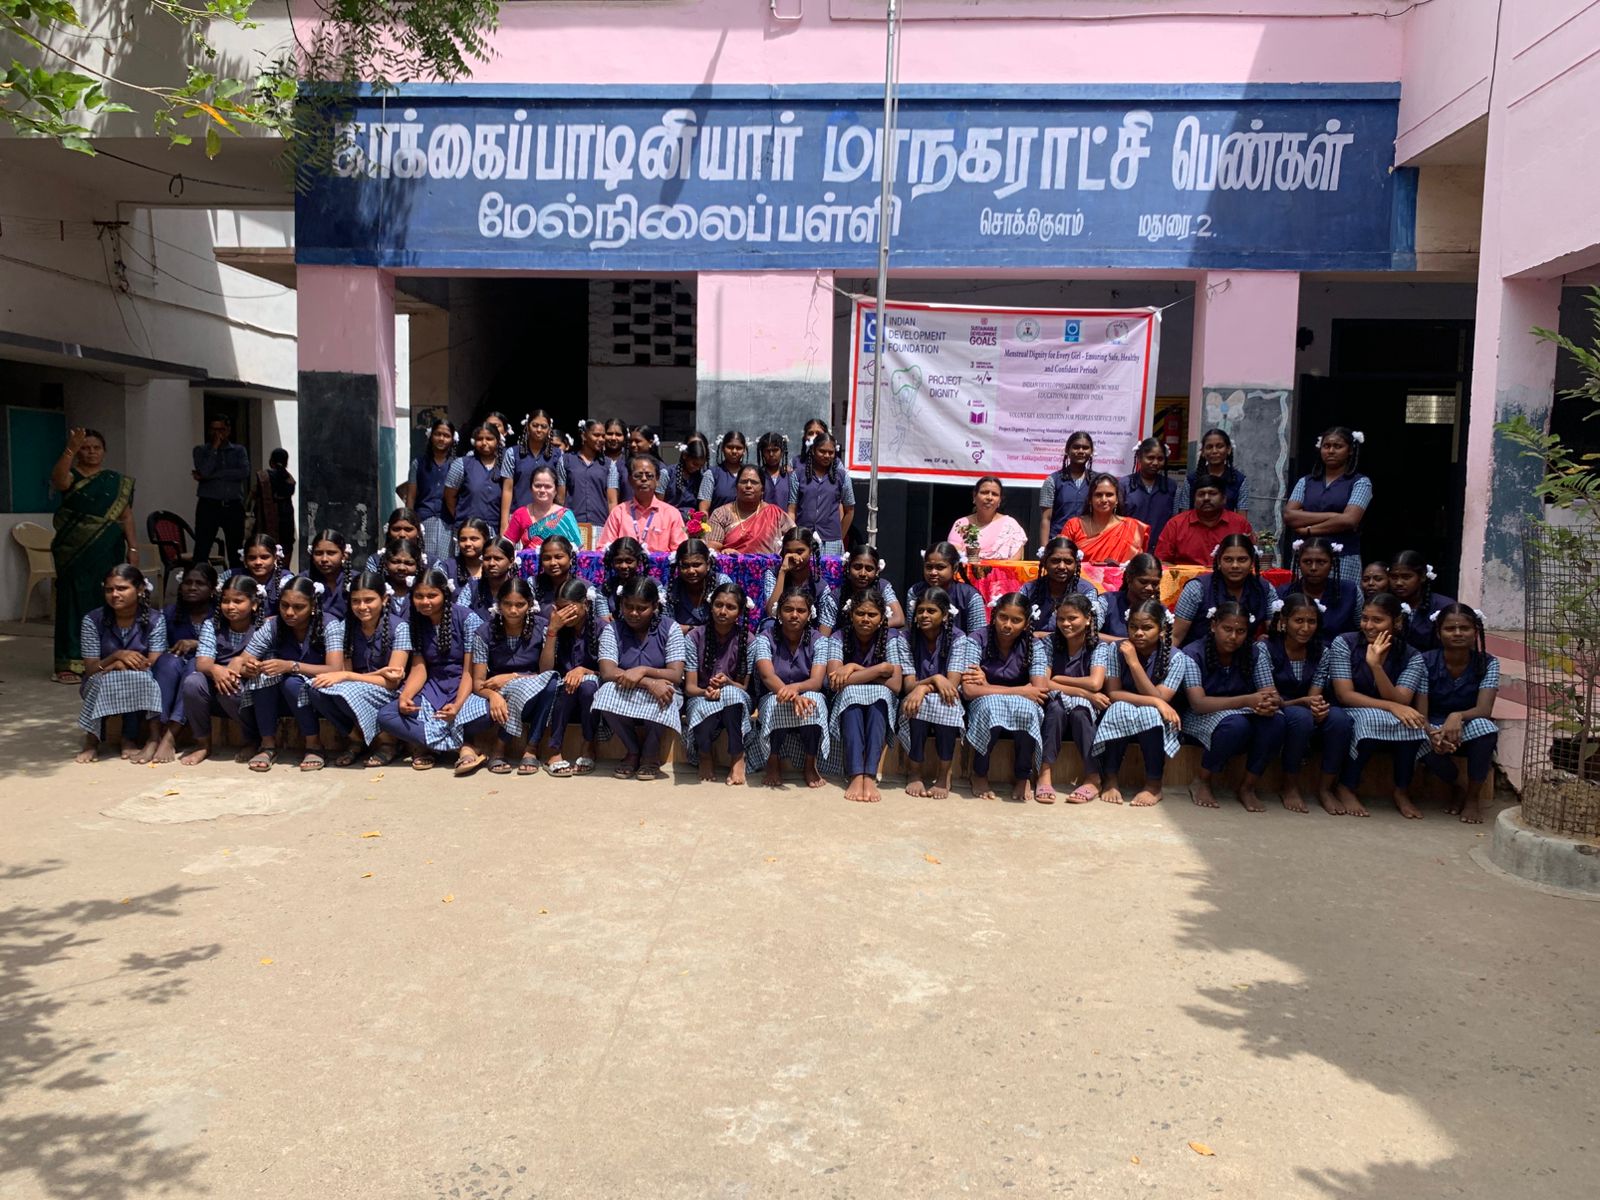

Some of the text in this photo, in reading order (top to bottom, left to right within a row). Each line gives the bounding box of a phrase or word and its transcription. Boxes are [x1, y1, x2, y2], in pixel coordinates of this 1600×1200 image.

[822, 110, 1153, 202] மாநகராட்சி
[1172, 116, 1354, 192] பெண்கள்
[477, 191, 902, 250] மேல்நிலைப்பள்ளி
[888, 316, 917, 326] INDIAN
[888, 330, 947, 341] DEVELOPMENT
[969, 336, 997, 346] GOALS
[888, 343, 940, 354] FOUNDATION
[1004, 349, 1029, 357] Menstrual
[1029, 350, 1048, 360] Dignity
[1048, 351, 1056, 359] for
[1056, 351, 1070, 361] Every
[1070, 351, 1081, 360] Girl
[1085, 352, 1108, 362] Ensuring
[1120, 353, 1140, 363] Healthy
[1054, 366, 1079, 374] Confident
[1079, 366, 1098, 374] Periods
[928, 375, 962, 385] PROJECT
[929, 388, 959, 398] DIGNITY
